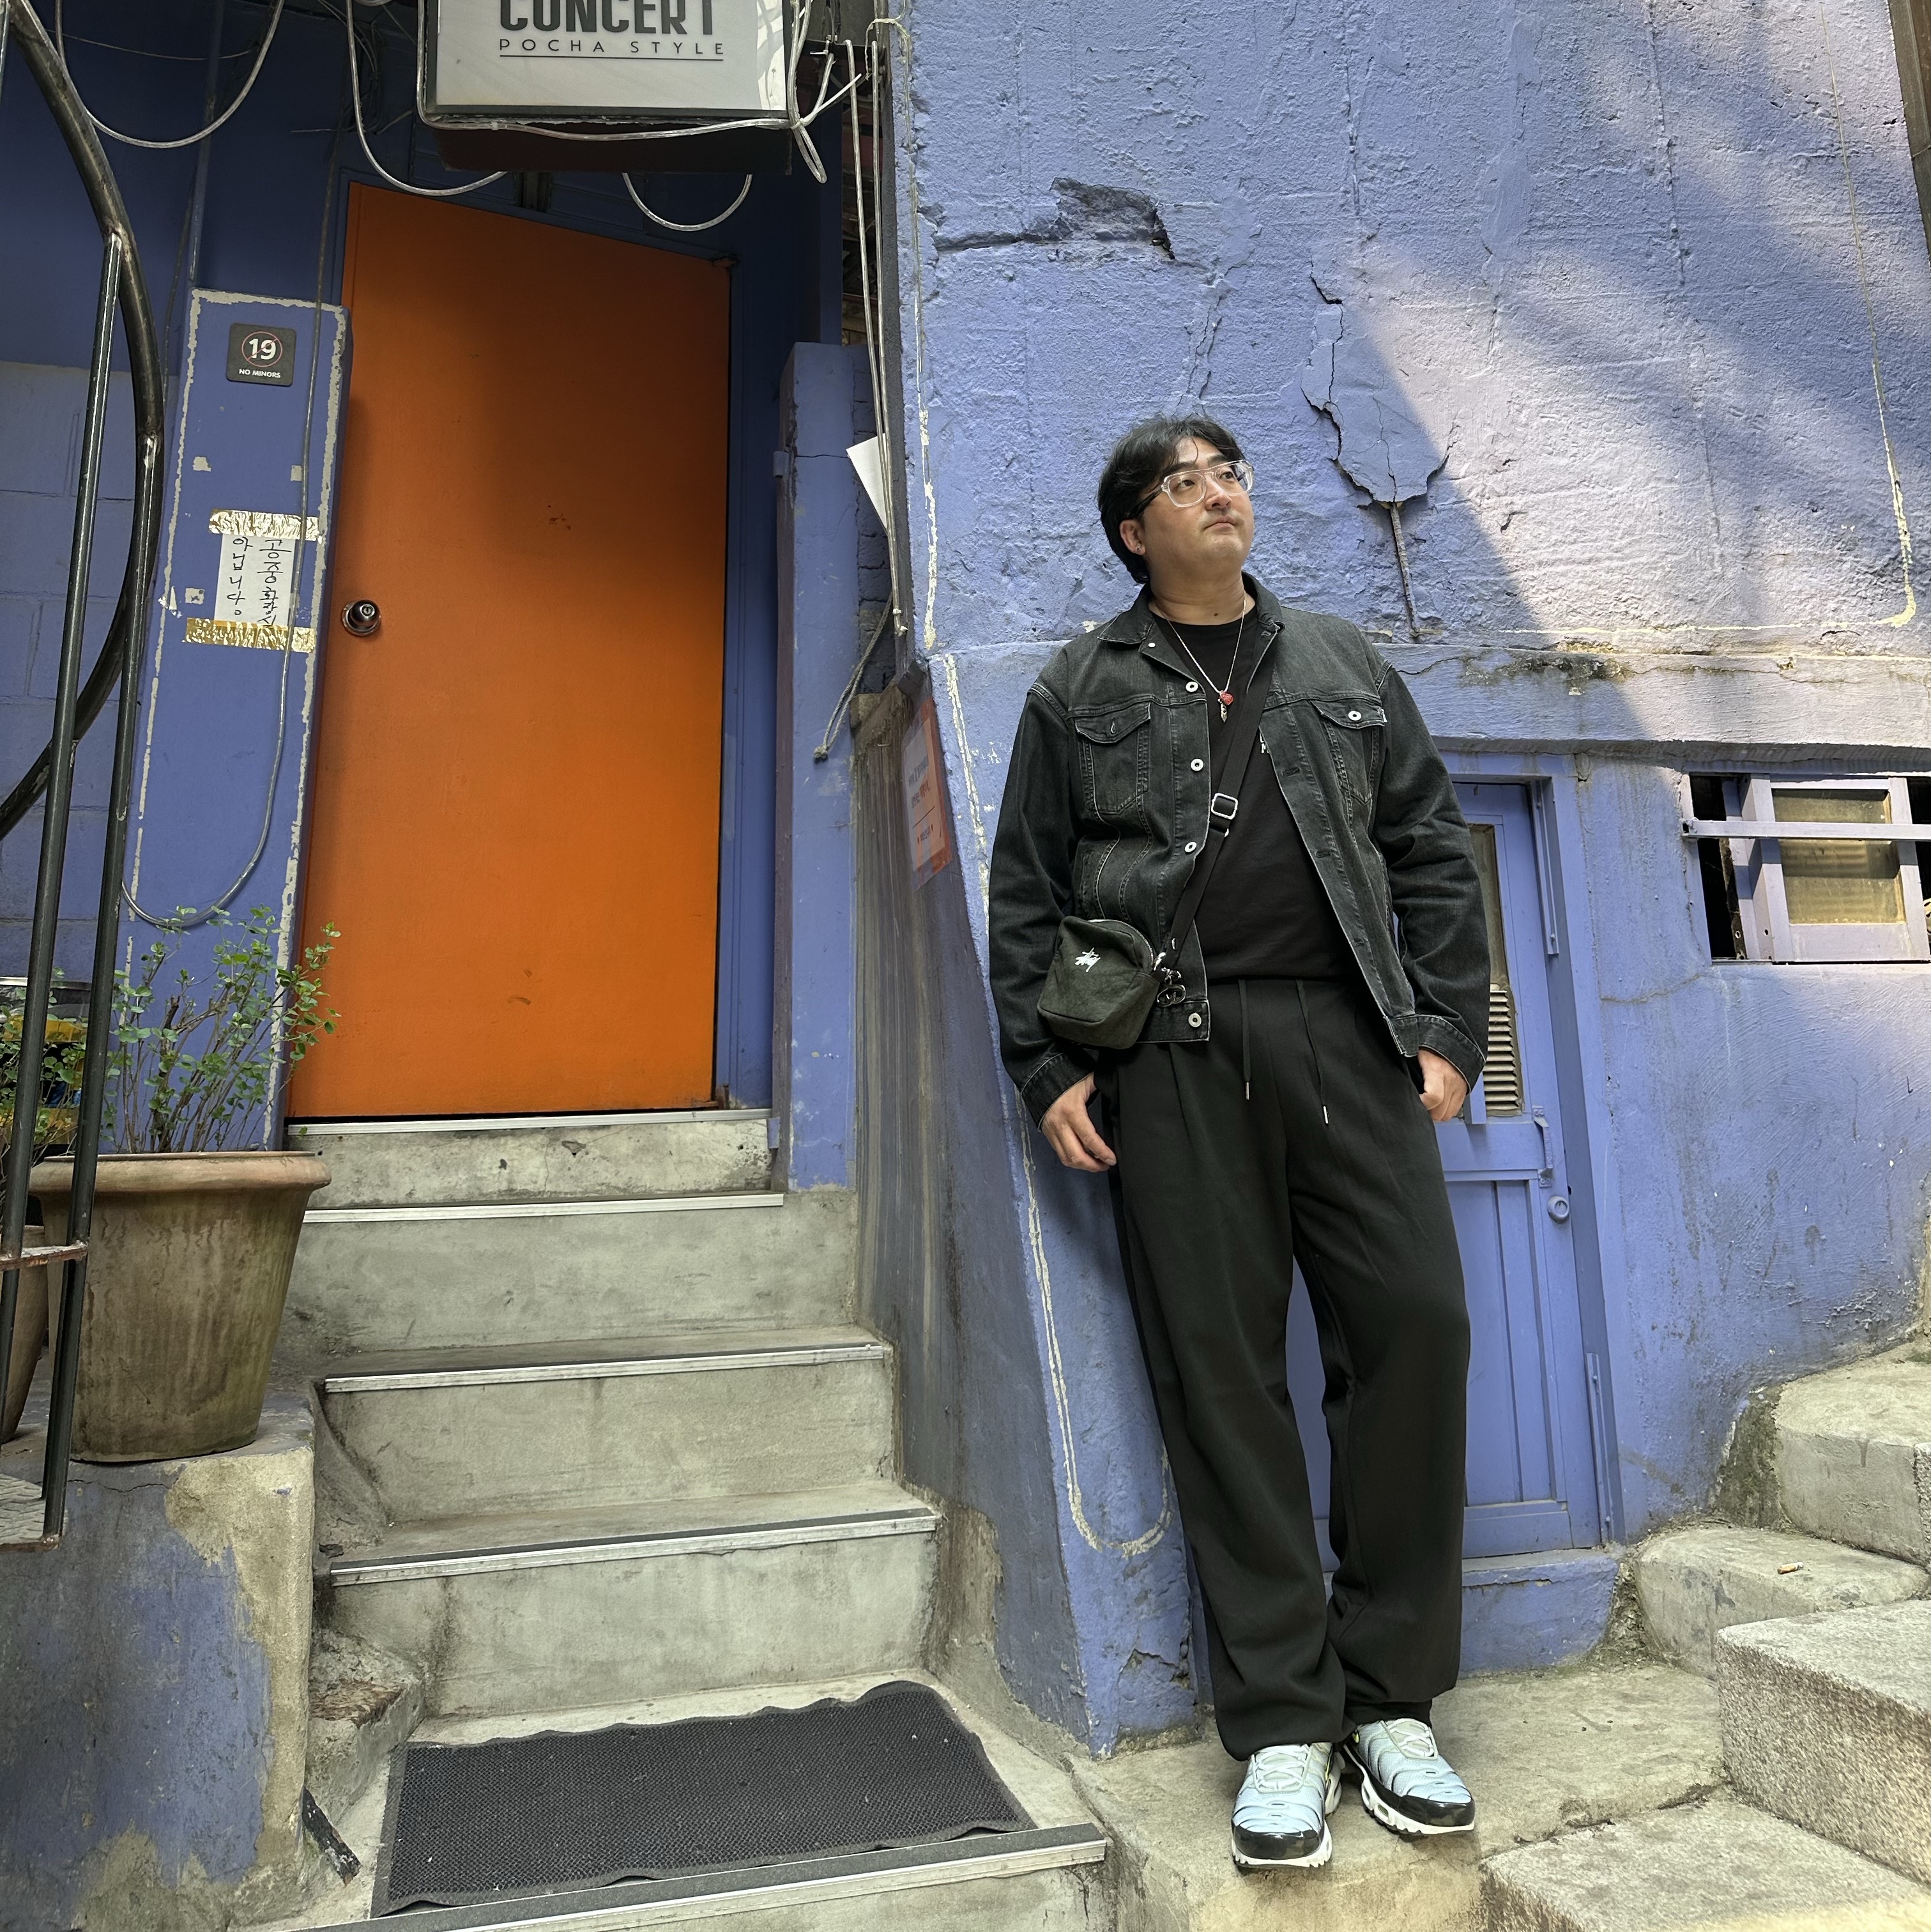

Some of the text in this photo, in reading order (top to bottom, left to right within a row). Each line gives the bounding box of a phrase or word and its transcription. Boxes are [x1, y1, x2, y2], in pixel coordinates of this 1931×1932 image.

[500, 39, 724, 55] POCHA STYLE
[248, 338, 277, 360] 19
[252, 370, 281, 378] MINORS
